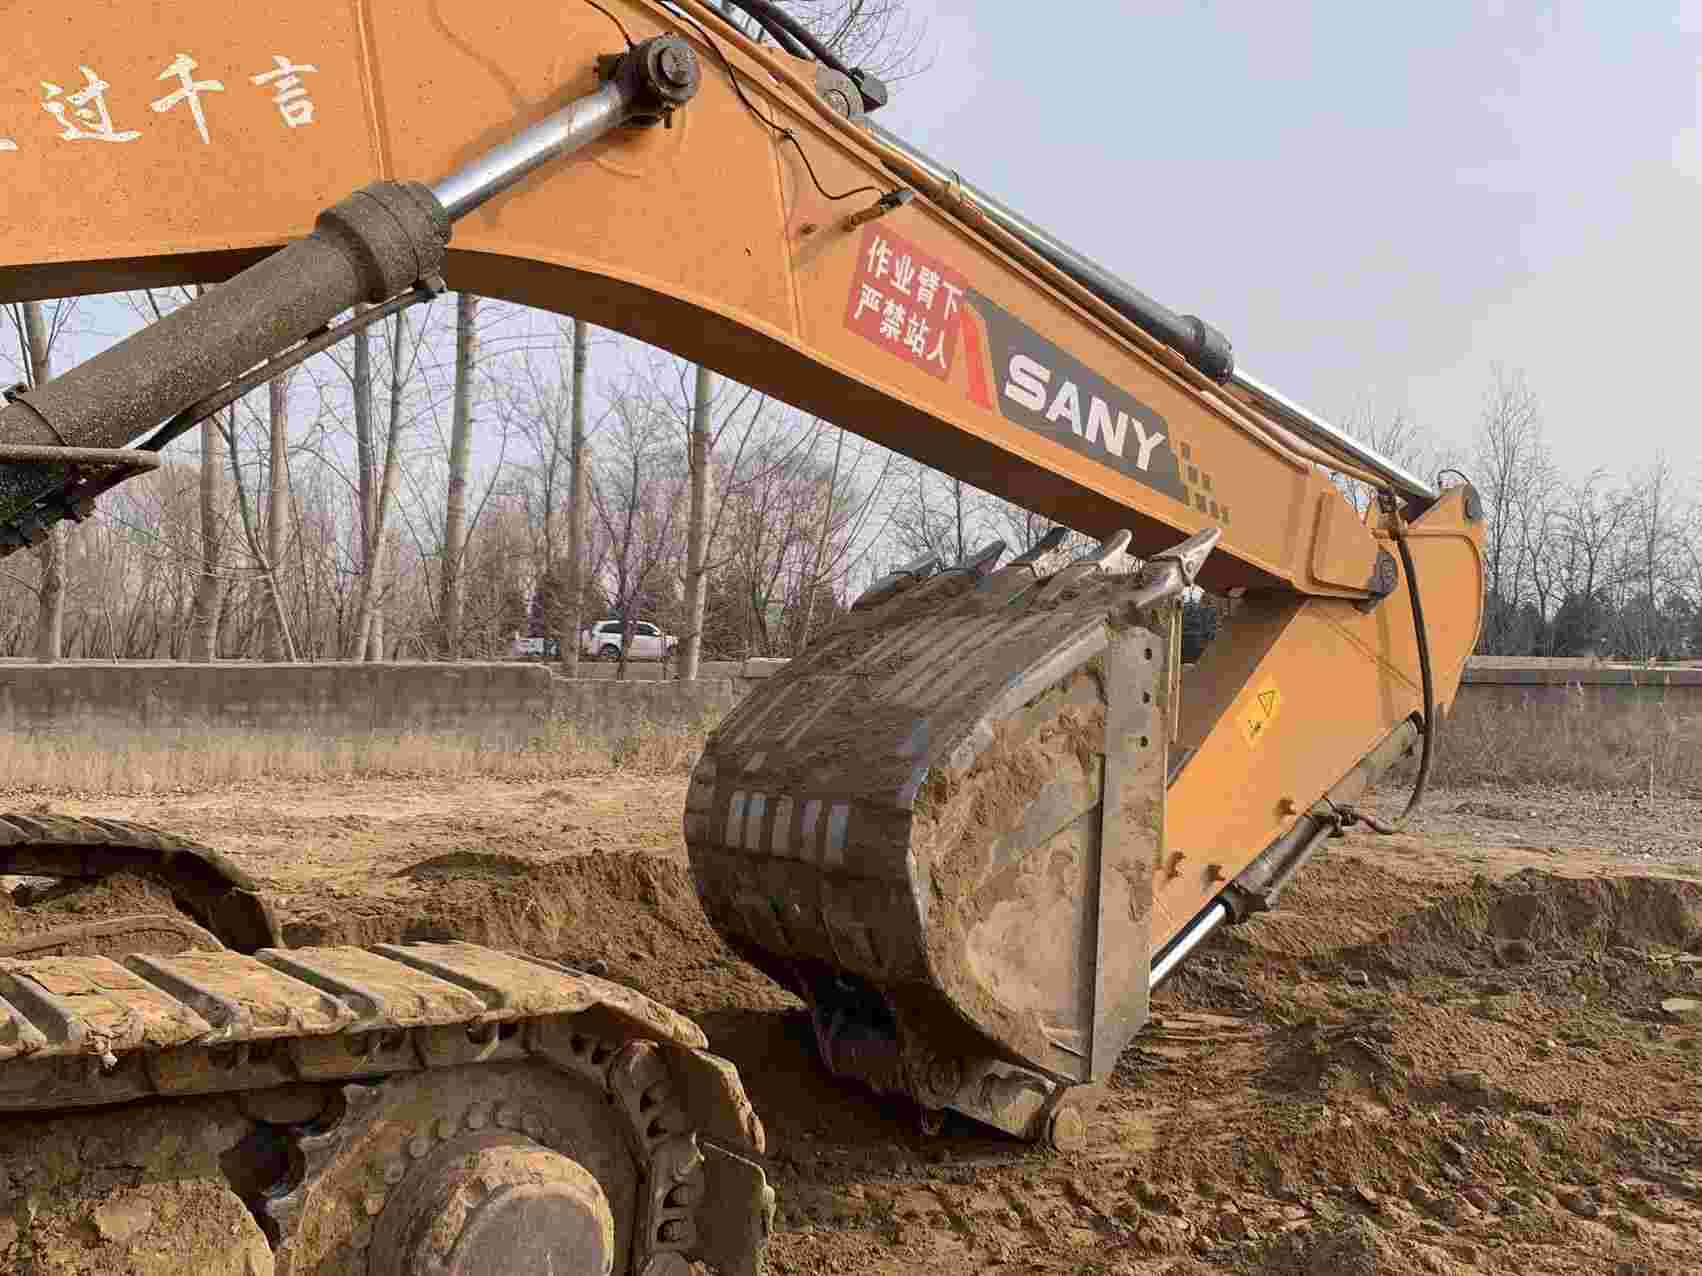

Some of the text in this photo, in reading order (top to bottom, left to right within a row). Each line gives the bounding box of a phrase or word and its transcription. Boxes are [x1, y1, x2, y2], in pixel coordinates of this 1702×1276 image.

[0, 50, 320, 150] 过千言
[866, 235, 963, 321] 作业臂下
[853, 283, 948, 369] 严禁站人
[1004, 353, 1166, 472] SANY
